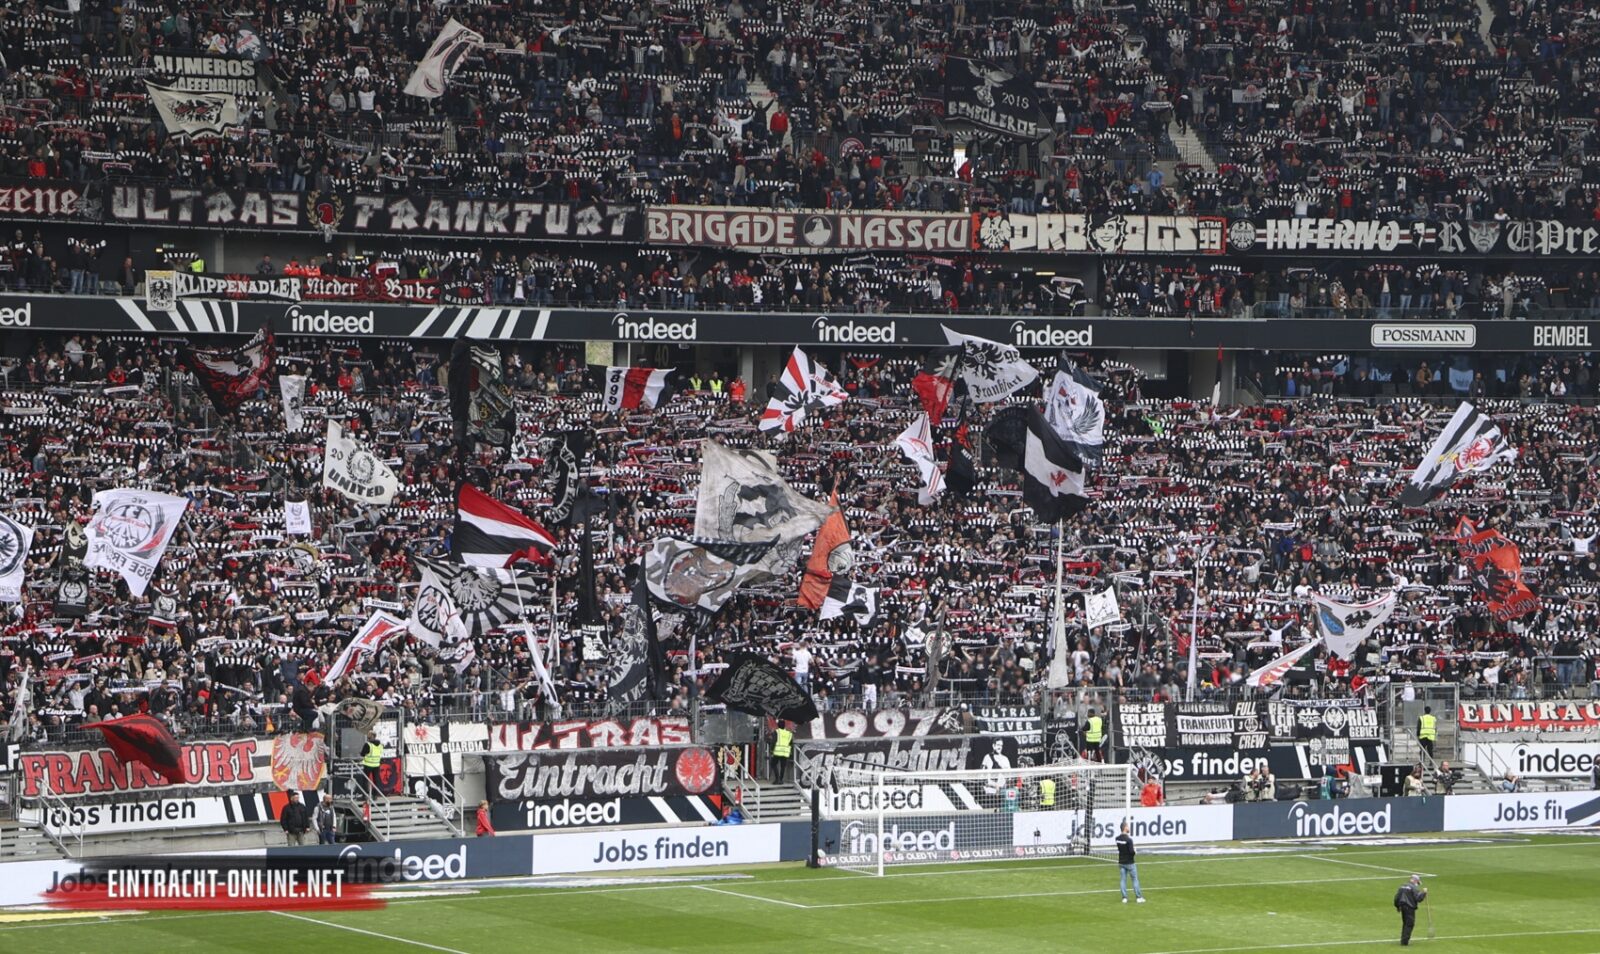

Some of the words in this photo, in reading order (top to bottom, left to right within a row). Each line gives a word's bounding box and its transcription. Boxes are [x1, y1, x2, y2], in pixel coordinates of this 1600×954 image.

[111, 186, 299, 225] ULTRAS
[354, 195, 636, 237] FRANKFURT
[647, 211, 795, 247] BRIGADE
[840, 215, 969, 250] NASSAU
[1200, 229, 1221, 249] 99
[1266, 218, 1401, 251] INFERNO
[176, 272, 301, 301] KLIPPENADLER
[305, 277, 359, 296] Nieder
[385, 277, 437, 299] Bube
[289, 308, 374, 334] indeed
[616, 315, 697, 341] indeed
[817, 319, 896, 344] indeed
[1015, 324, 1093, 346] indeed
[1382, 329, 1466, 343] POSSMANN
[1533, 326, 1592, 347] BEMBEL
[328, 468, 386, 498] UNITED
[981, 707, 1036, 718] ULTRAS
[1120, 713, 1165, 725] GRUPPE
[1235, 702, 1257, 715] FULL
[1347, 709, 1378, 726] RIED
[489, 717, 691, 750] ULTRAS
[810, 708, 945, 739] 1997
[987, 721, 1034, 731] NEVER
[1121, 725, 1167, 736] STADION
[1181, 717, 1234, 730] FRANKFURT
[1349, 726, 1378, 737] GEBIET
[441, 741, 485, 753] GUARDIA
[1123, 735, 1167, 747] VERBOT
[1181, 732, 1233, 745] HOOLIGANS
[1238, 735, 1266, 749] CREW
[498, 751, 668, 800] Eintracht
[1191, 751, 1269, 776] finden
[833, 785, 924, 812] indeed
[109, 799, 196, 824] finden
[526, 798, 621, 828] indeed
[1293, 802, 1392, 837] indeed
[1494, 800, 1539, 823] Jobs
[849, 821, 955, 854] indeed
[1127, 814, 1187, 838] inden
[593, 839, 648, 864] Jobs
[654, 836, 729, 860] finden
